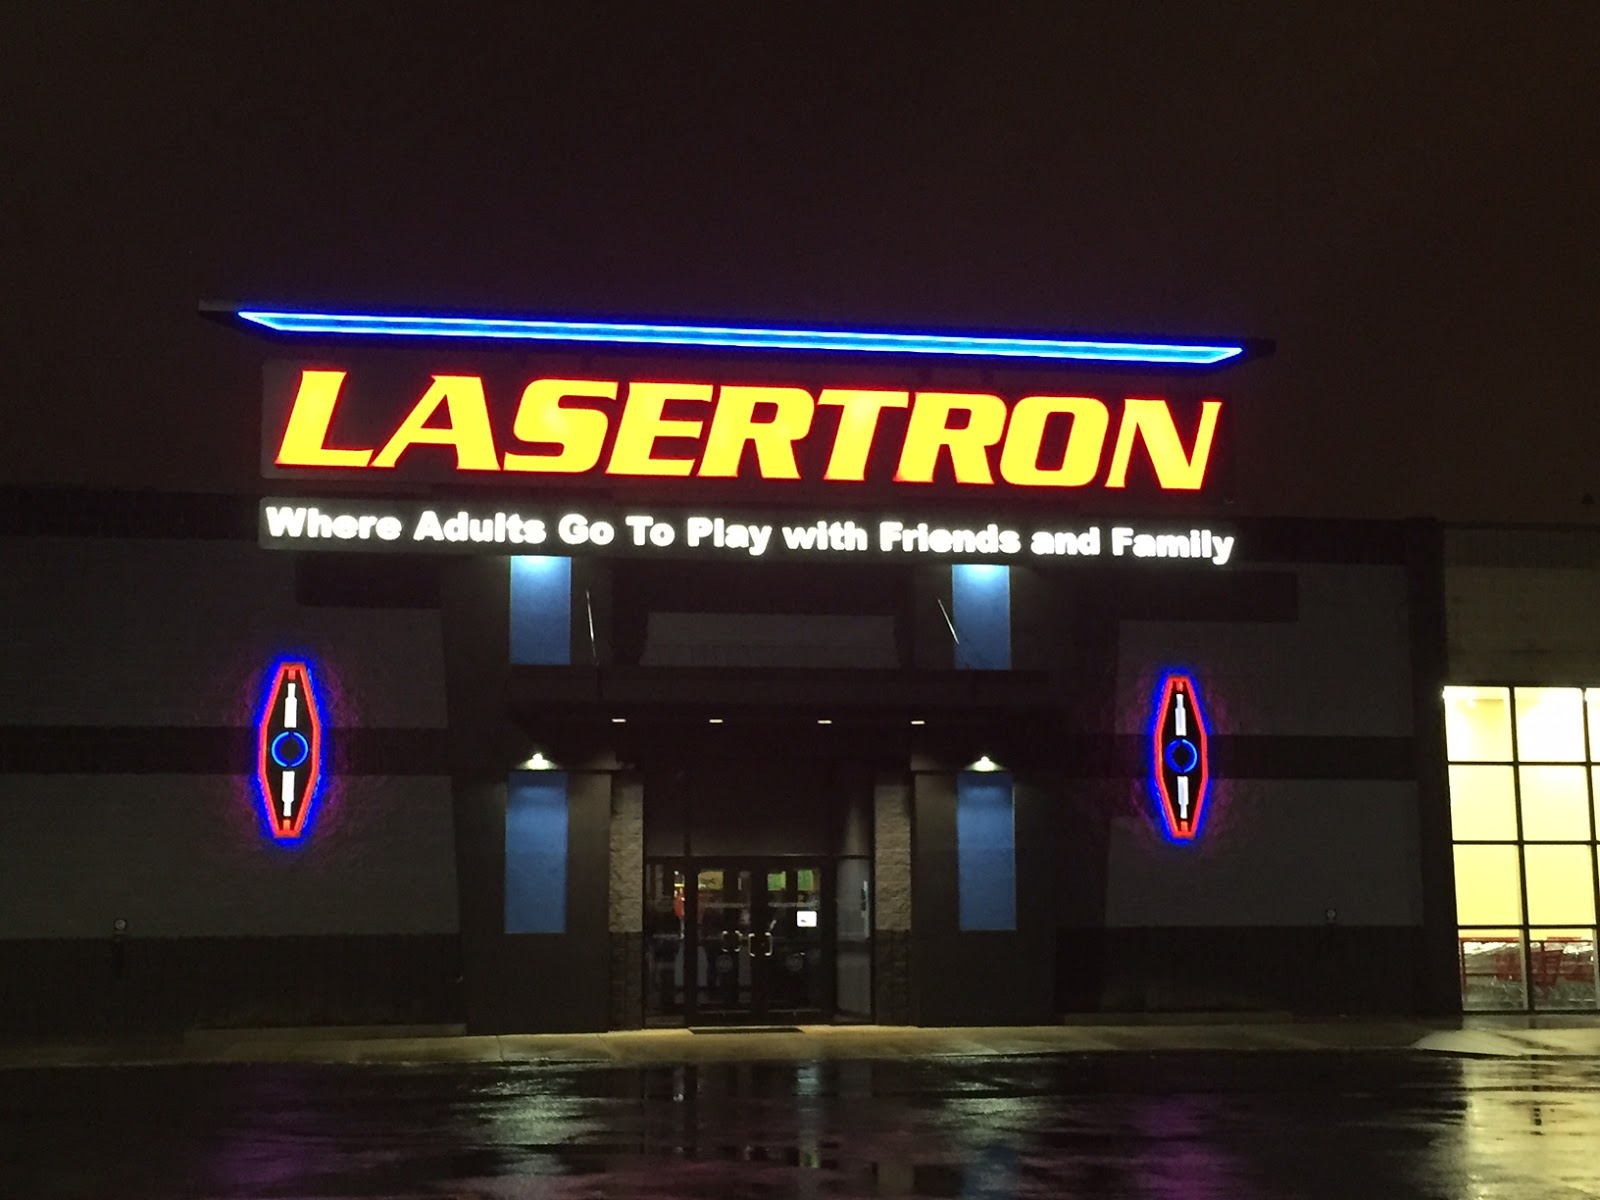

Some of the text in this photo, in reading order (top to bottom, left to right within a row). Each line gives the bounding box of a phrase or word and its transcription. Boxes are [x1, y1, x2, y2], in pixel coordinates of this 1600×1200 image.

[275, 370, 1222, 490] LASERTRON
[266, 507, 1235, 565] Where Adults Go To Play with Friends and Family
